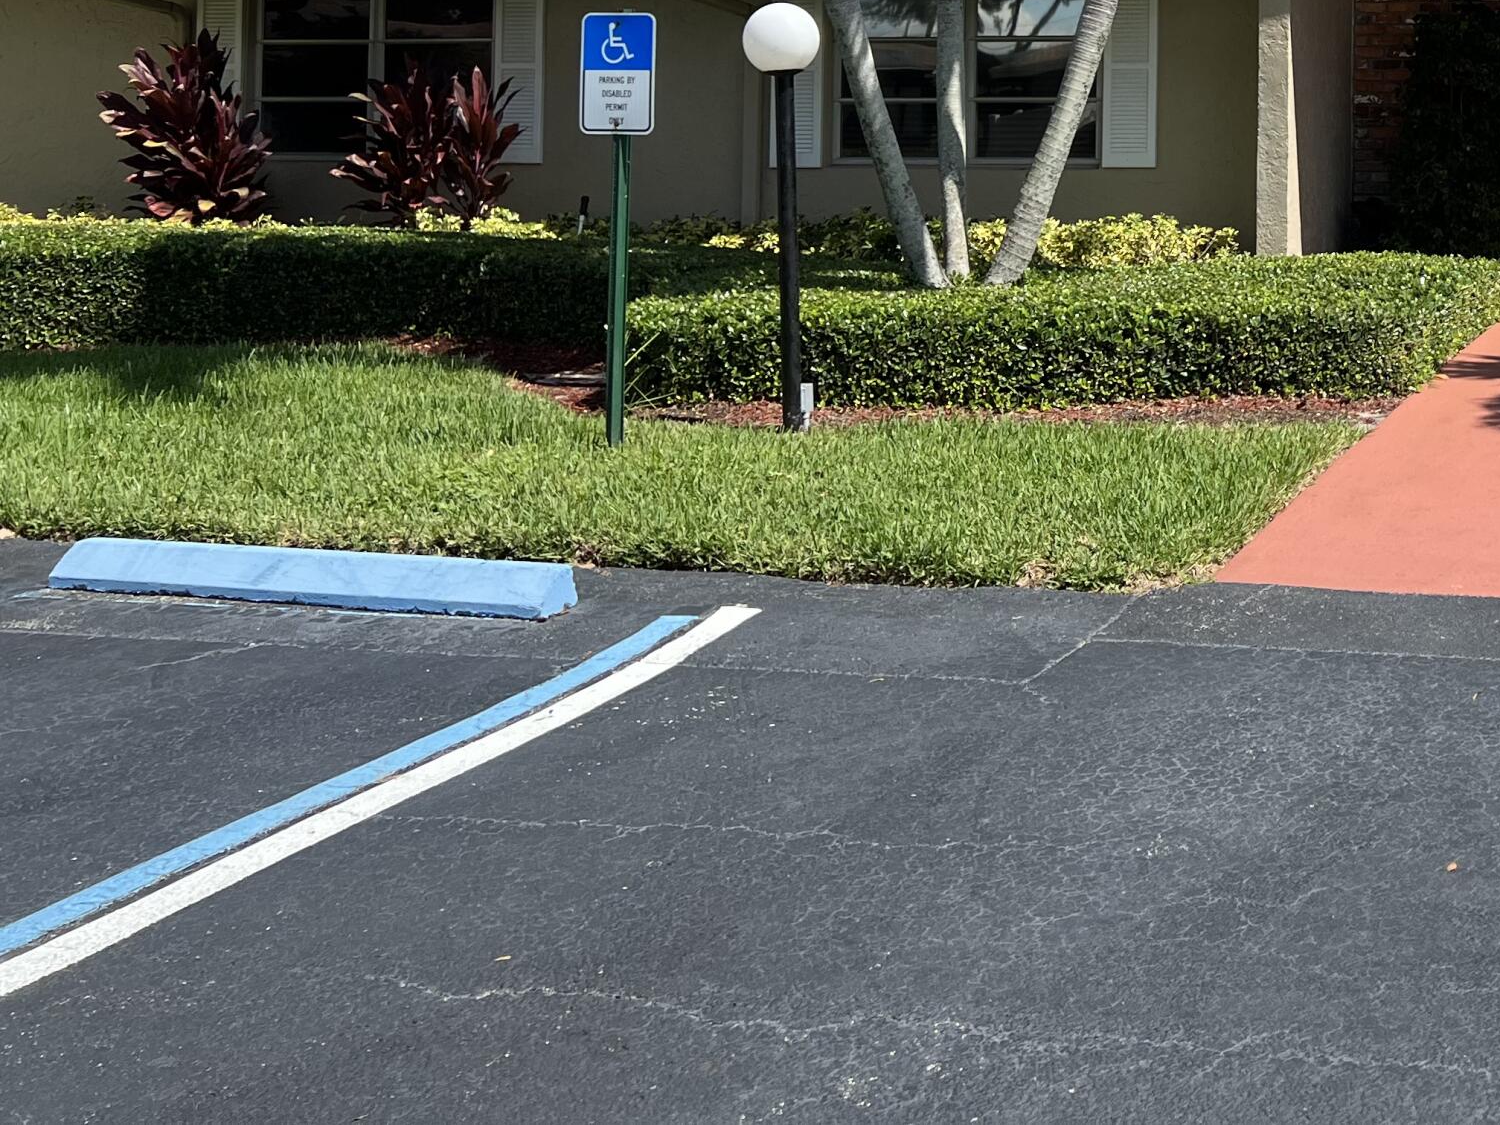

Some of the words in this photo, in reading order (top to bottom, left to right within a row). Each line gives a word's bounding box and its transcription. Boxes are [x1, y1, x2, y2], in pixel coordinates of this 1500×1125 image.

[598, 76, 624, 84] PARKING
[626, 76, 636, 84] BY
[602, 90, 632, 98] DISABLED
[605, 103, 628, 111] PERMIT
